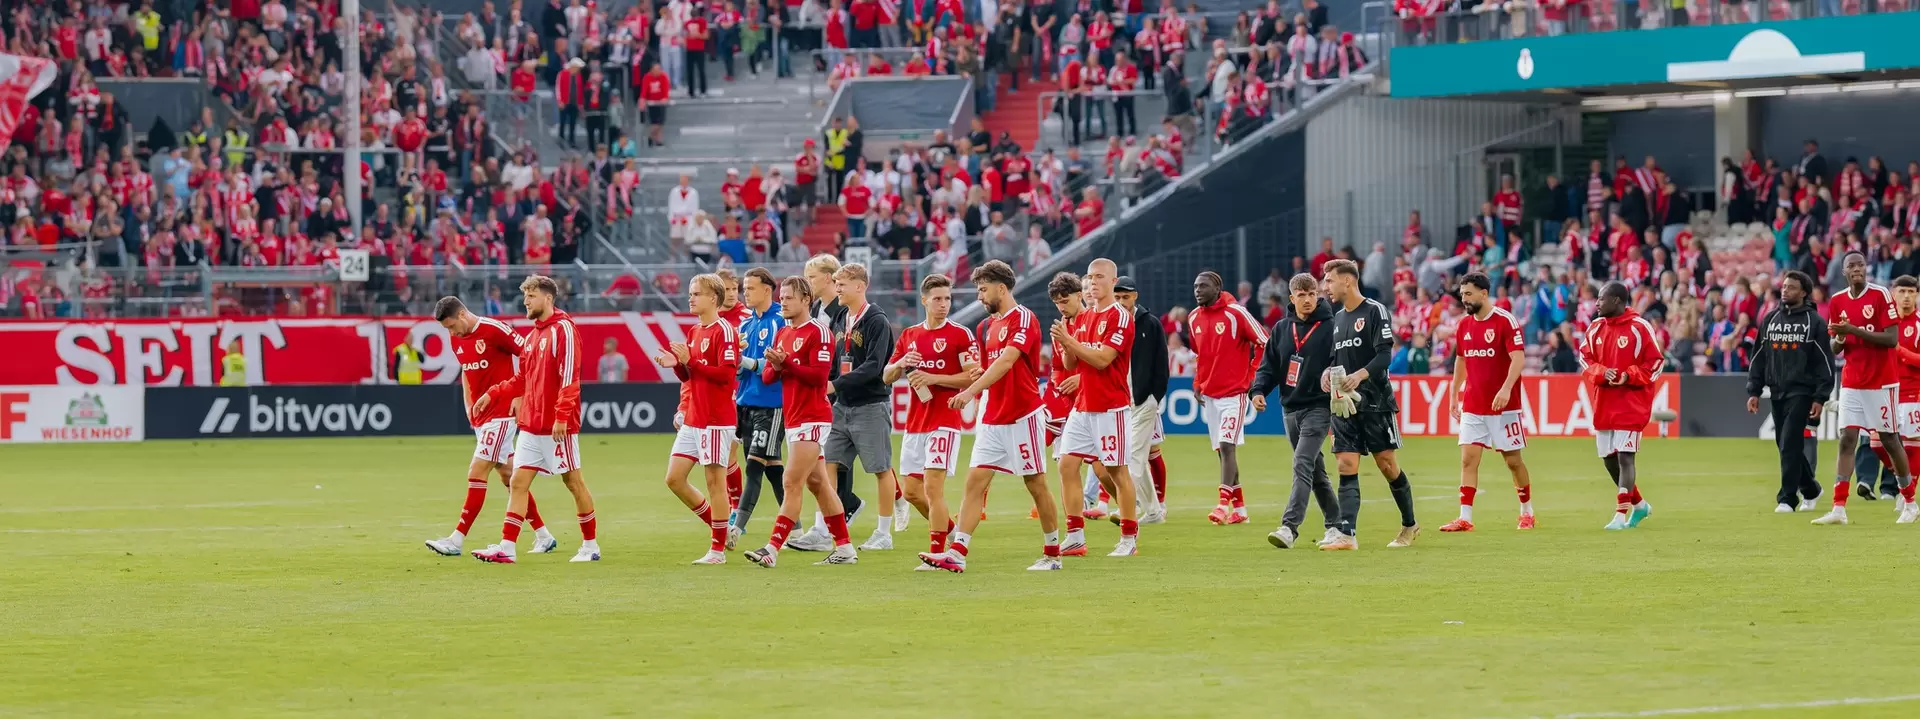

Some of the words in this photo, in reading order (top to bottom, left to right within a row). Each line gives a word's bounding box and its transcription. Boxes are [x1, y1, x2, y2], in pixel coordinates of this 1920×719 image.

[345, 255, 364, 273] 24
[1767, 322, 1810, 333] MARTY
[56, 321, 287, 386] SEIT
[0, 392, 31, 440] F
[249, 395, 393, 432] bitvavo
[1880, 405, 1888, 420] 2
[1220, 417, 1237, 430] 23
[1504, 422, 1520, 438] 10
[41, 427, 133, 441] WIESENHOF
[481, 430, 495, 446] 16
[701, 434, 707, 449] 8
[751, 430, 769, 448] 29
[929, 437, 947, 453] 20
[1100, 435, 1117, 451] 13
[555, 444, 564, 459] 4
[1018, 443, 1030, 460] 5
